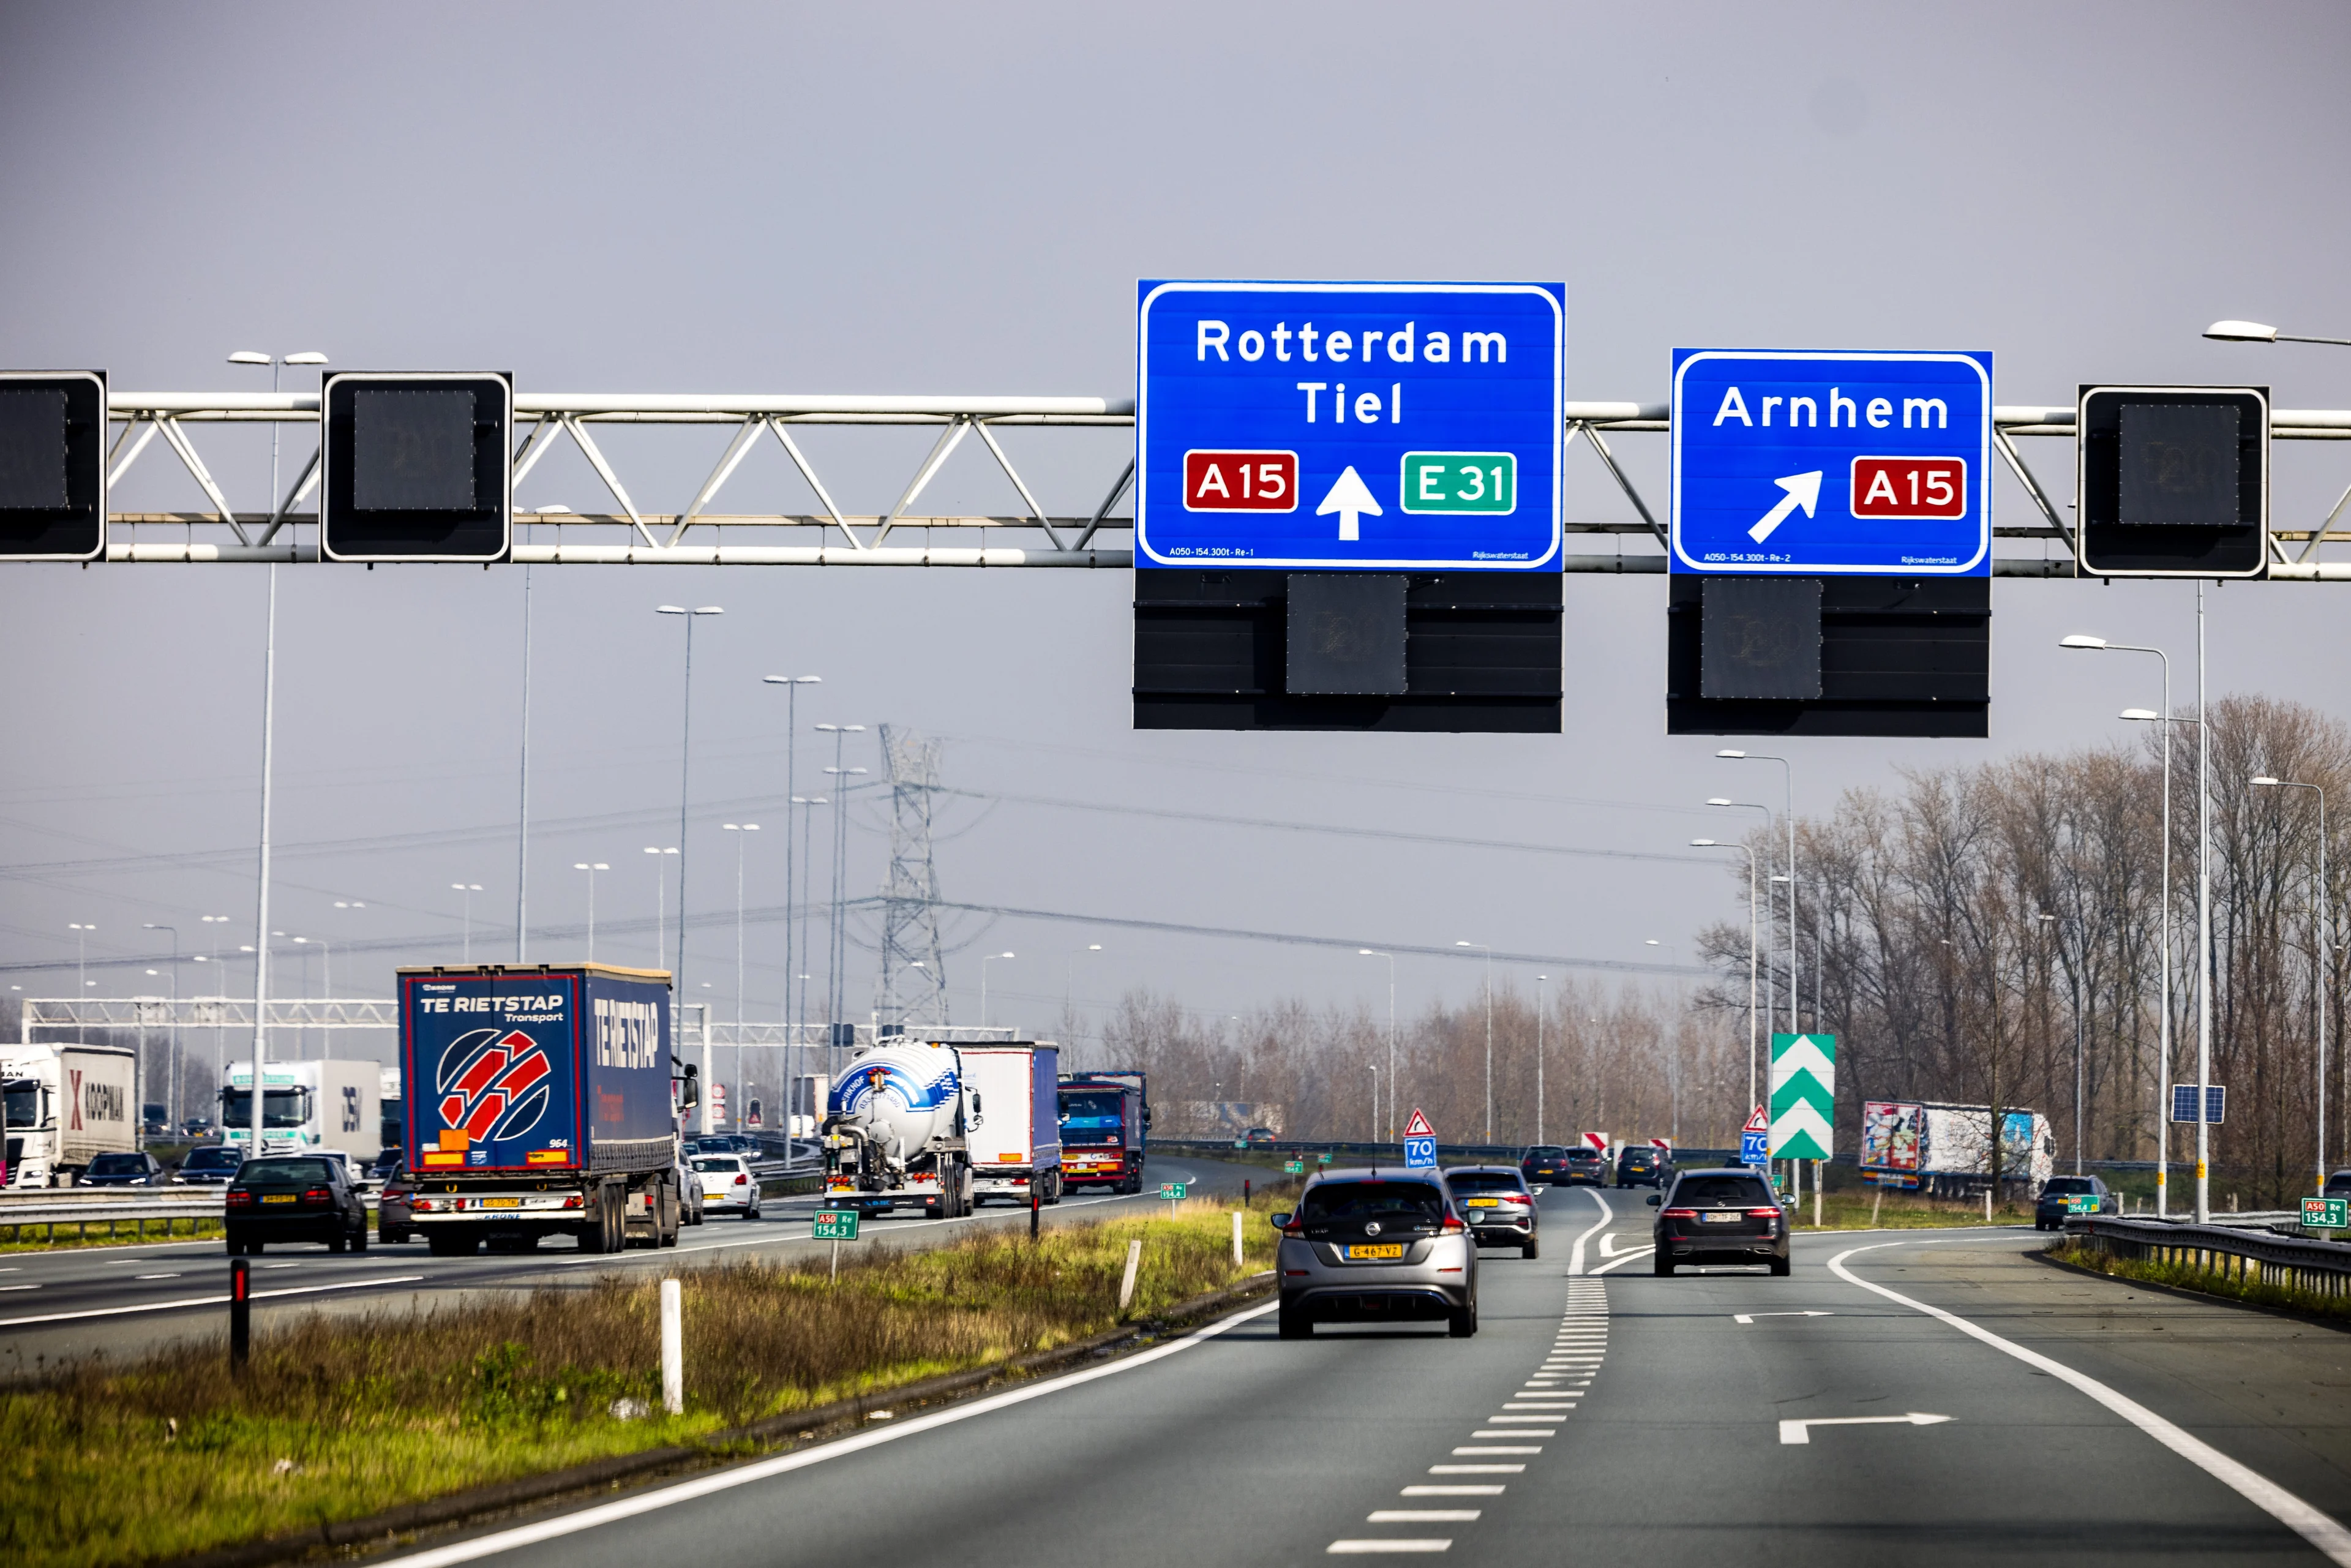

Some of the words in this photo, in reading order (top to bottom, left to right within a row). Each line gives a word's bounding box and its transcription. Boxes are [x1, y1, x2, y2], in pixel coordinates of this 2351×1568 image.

[1198, 320, 1506, 362] Rotterdam
[1297, 383, 1400, 423] Tiel
[1713, 387, 1947, 428] Arnhem
[1197, 464, 1285, 499] A15
[1864, 470, 1954, 505] A15
[1472, 550, 1529, 560] Rijkswaterstaat
[1901, 555, 1957, 565] Rijkswaterstaat
[421, 998, 450, 1013] TE
[454, 995, 563, 1012] RIETSTAP
[504, 1013, 563, 1024] Transport
[594, 999, 609, 1067] TE
[549, 1139, 568, 1148] 964
[1408, 1141, 1433, 1156] 70
[2305, 1212, 2338, 1225] 154,3
[1354, 1247, 1398, 1257] G-467-VZ
